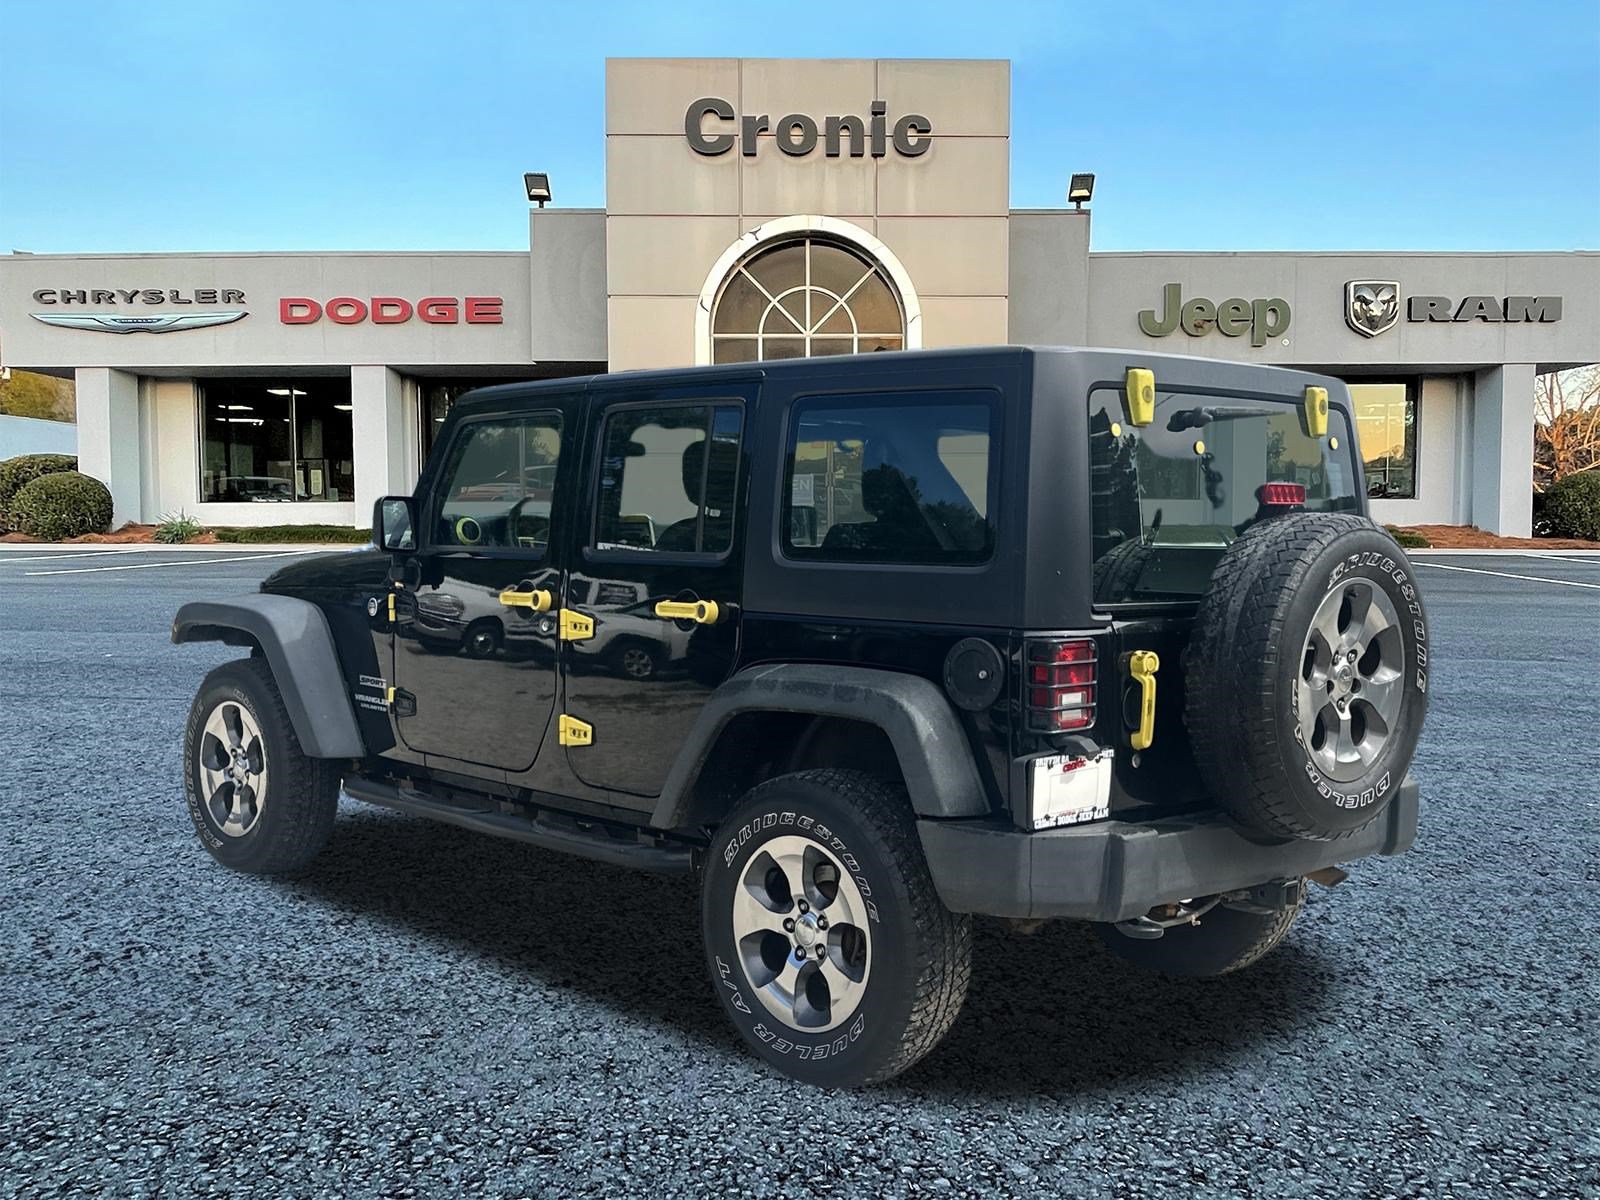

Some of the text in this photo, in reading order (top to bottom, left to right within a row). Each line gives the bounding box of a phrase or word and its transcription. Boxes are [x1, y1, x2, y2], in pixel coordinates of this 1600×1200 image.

[685, 97, 932, 157] Cronic
[32, 289, 246, 304] CHRYSLER
[280, 297, 504, 324] DODGE
[1138, 283, 1291, 347] Jeep
[1407, 296, 1563, 322] RAM
[1327, 552, 1426, 693] BRIDGESTONE
[1305, 761, 1390, 808] DUELER
[724, 811, 879, 923] BRIDGESTONE
[753, 1013, 864, 1060] DUELER
